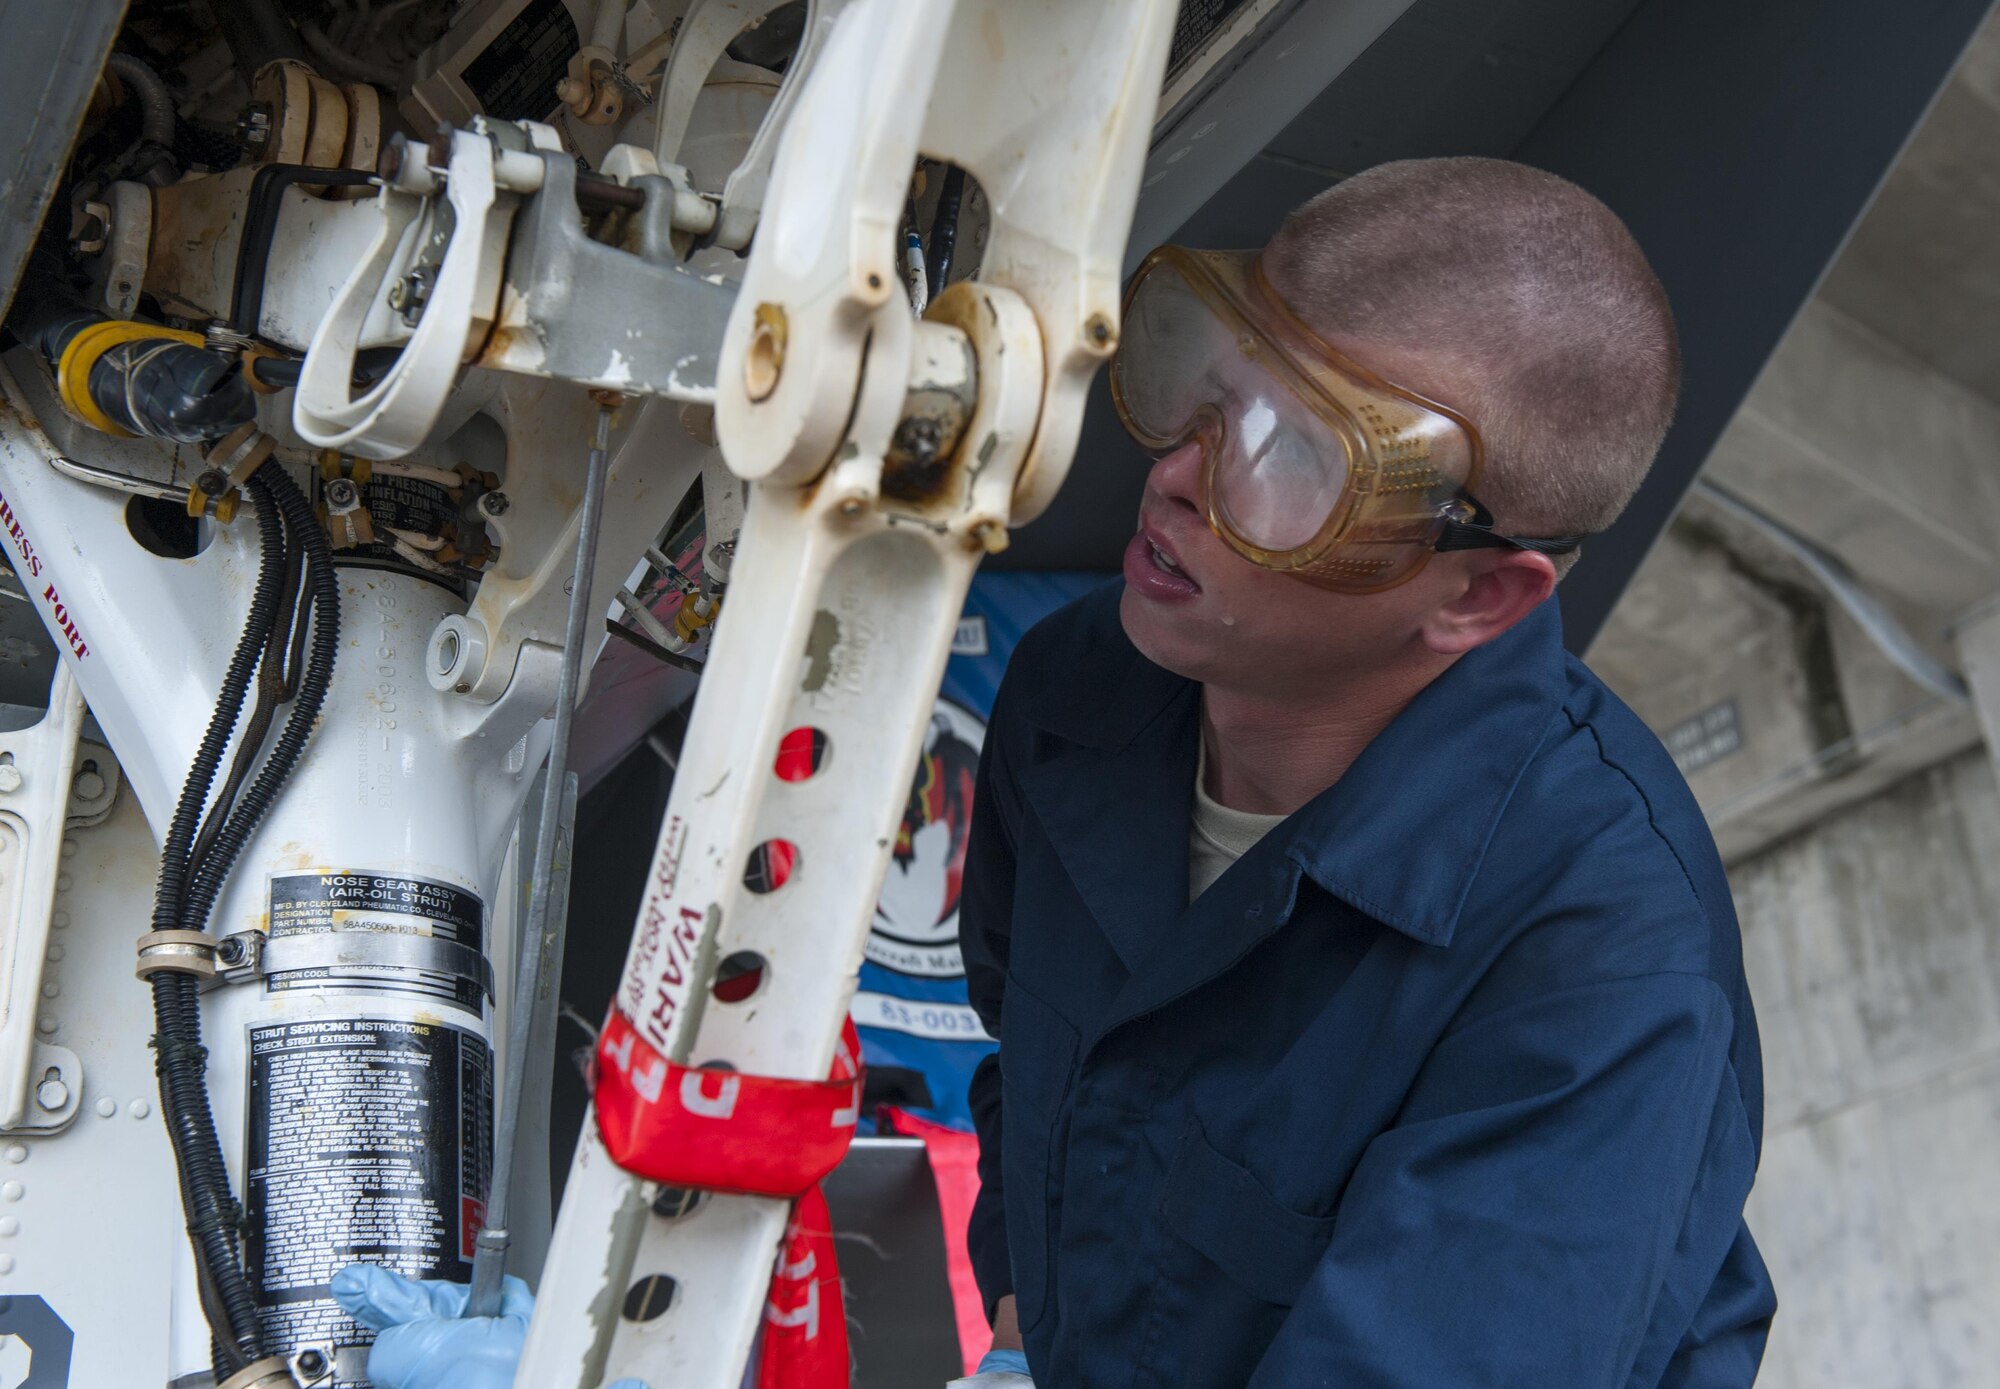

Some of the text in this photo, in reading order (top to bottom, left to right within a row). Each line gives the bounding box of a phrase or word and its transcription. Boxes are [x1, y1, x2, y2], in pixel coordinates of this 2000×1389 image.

[388, 475, 444, 503] PRESSURE
[370, 484, 431, 511] INFLATION
[0, 490, 90, 662] RESS PORT
[321, 876, 457, 901] NOSE GEAR ASSY
[273, 902, 294, 911] MFD.
[296, 901, 309, 909] BY
[310, 900, 361, 908] CLEVELAND
[329, 886, 452, 913] (AIR-OIL STRUT)
[273, 909, 330, 919] DESIGNATION
[273, 917, 333, 928] PART NUMBER
[273, 926, 332, 937] CONTRACTOR
[270, 970, 303, 981] DESIGN
[303, 970, 329, 978] CODE
[270, 982, 289, 990] NSN
[252, 1022, 430, 1041] STRUT SERVICING INSTRUCTIONS
[253, 1040, 284, 1052] CHECK
[286, 1036, 317, 1047] STRUT
